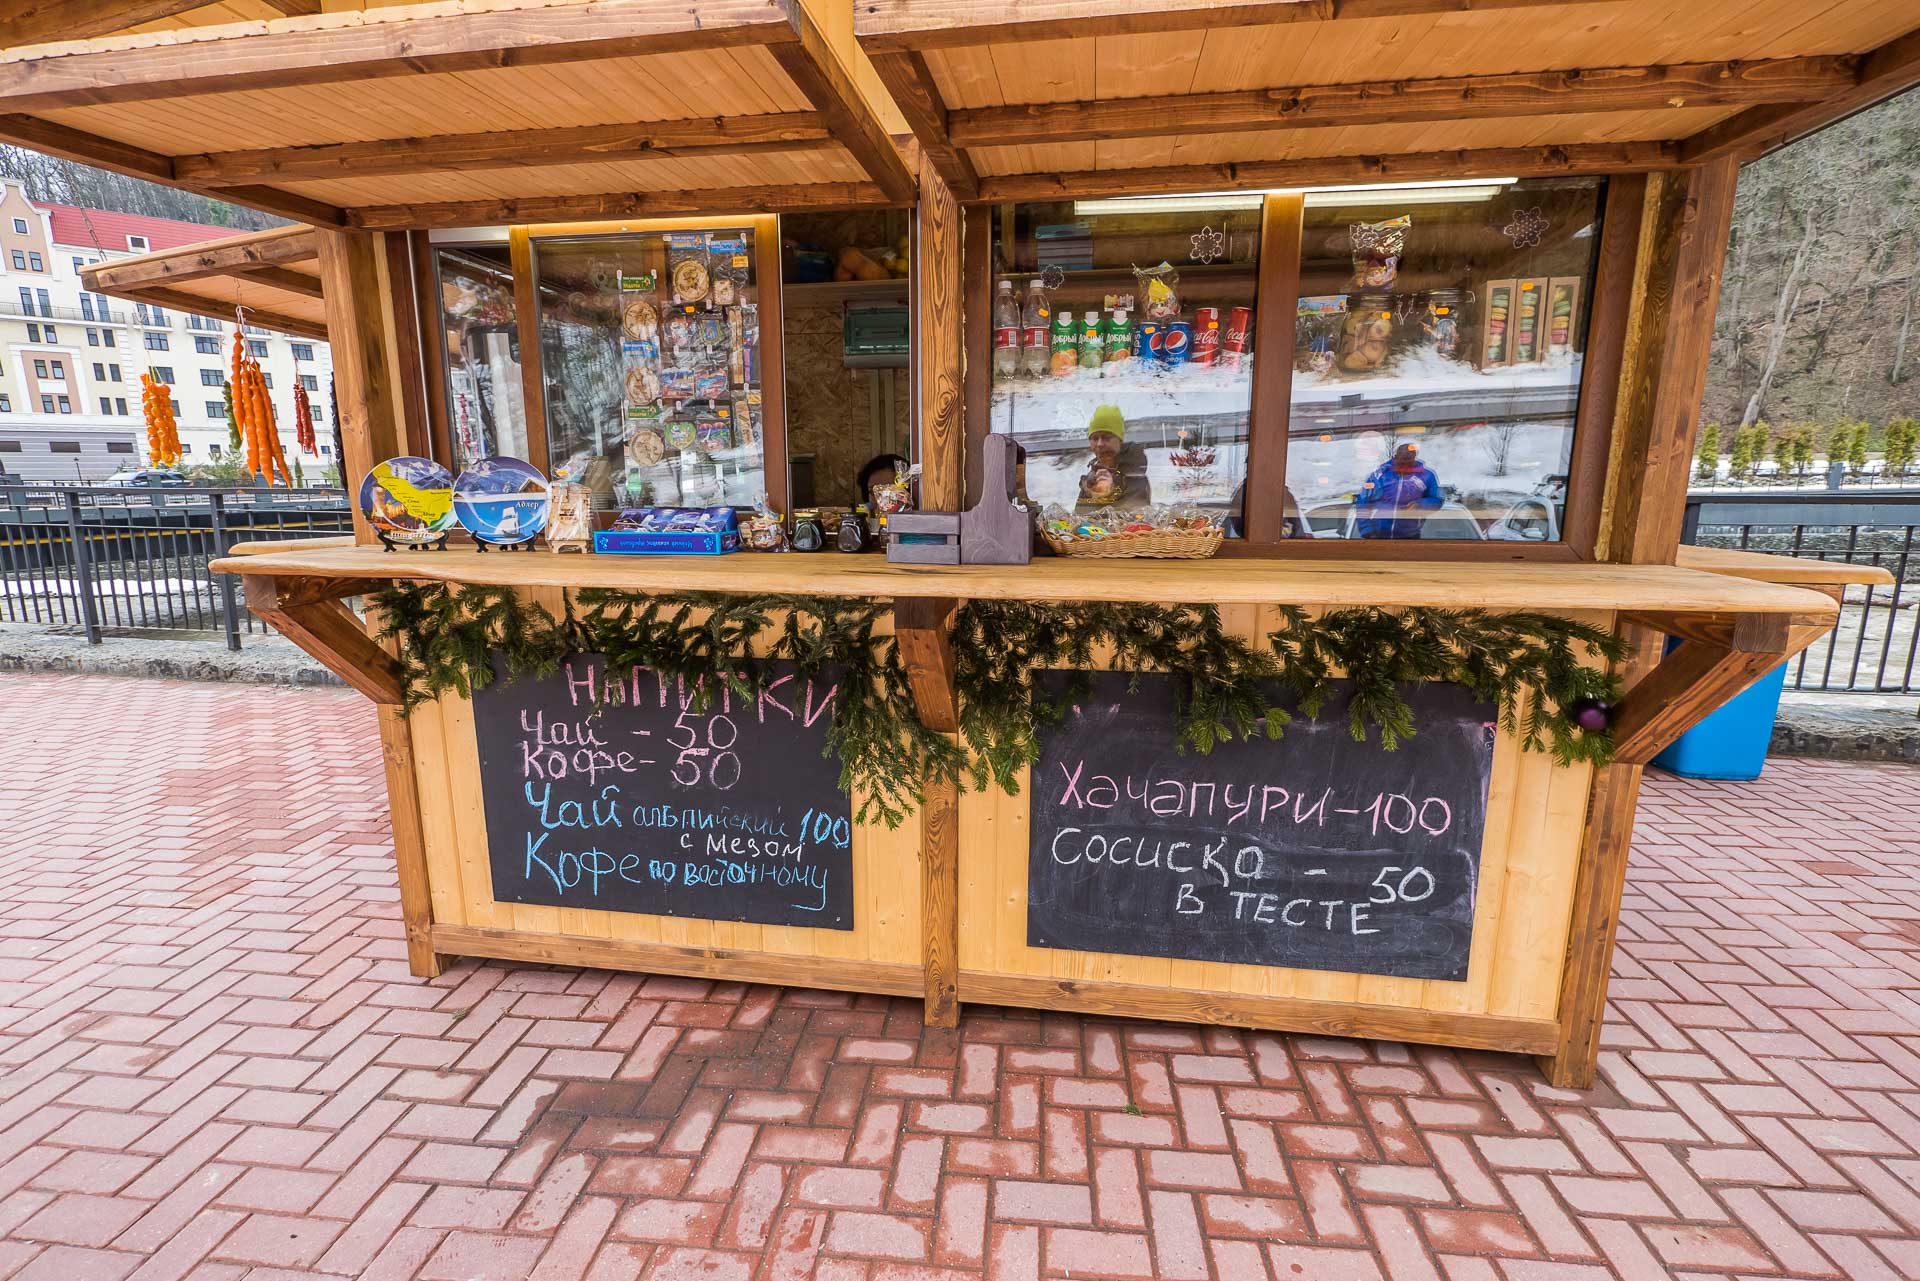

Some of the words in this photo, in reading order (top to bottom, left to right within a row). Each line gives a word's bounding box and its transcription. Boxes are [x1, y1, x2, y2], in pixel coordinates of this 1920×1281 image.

[516, 502, 539, 510] Адлер
[520, 708, 609, 747] Чай
[665, 711, 738, 750] 50
[670, 747, 742, 791] 50
[524, 781, 623, 830] Чай
[799, 807, 850, 849] 100
[525, 831, 641, 896] Кофе
[1051, 827, 1265, 888] Сосиска
[1368, 865, 1437, 904] 50
[1229, 891, 1382, 937] ТЕСТЕ
